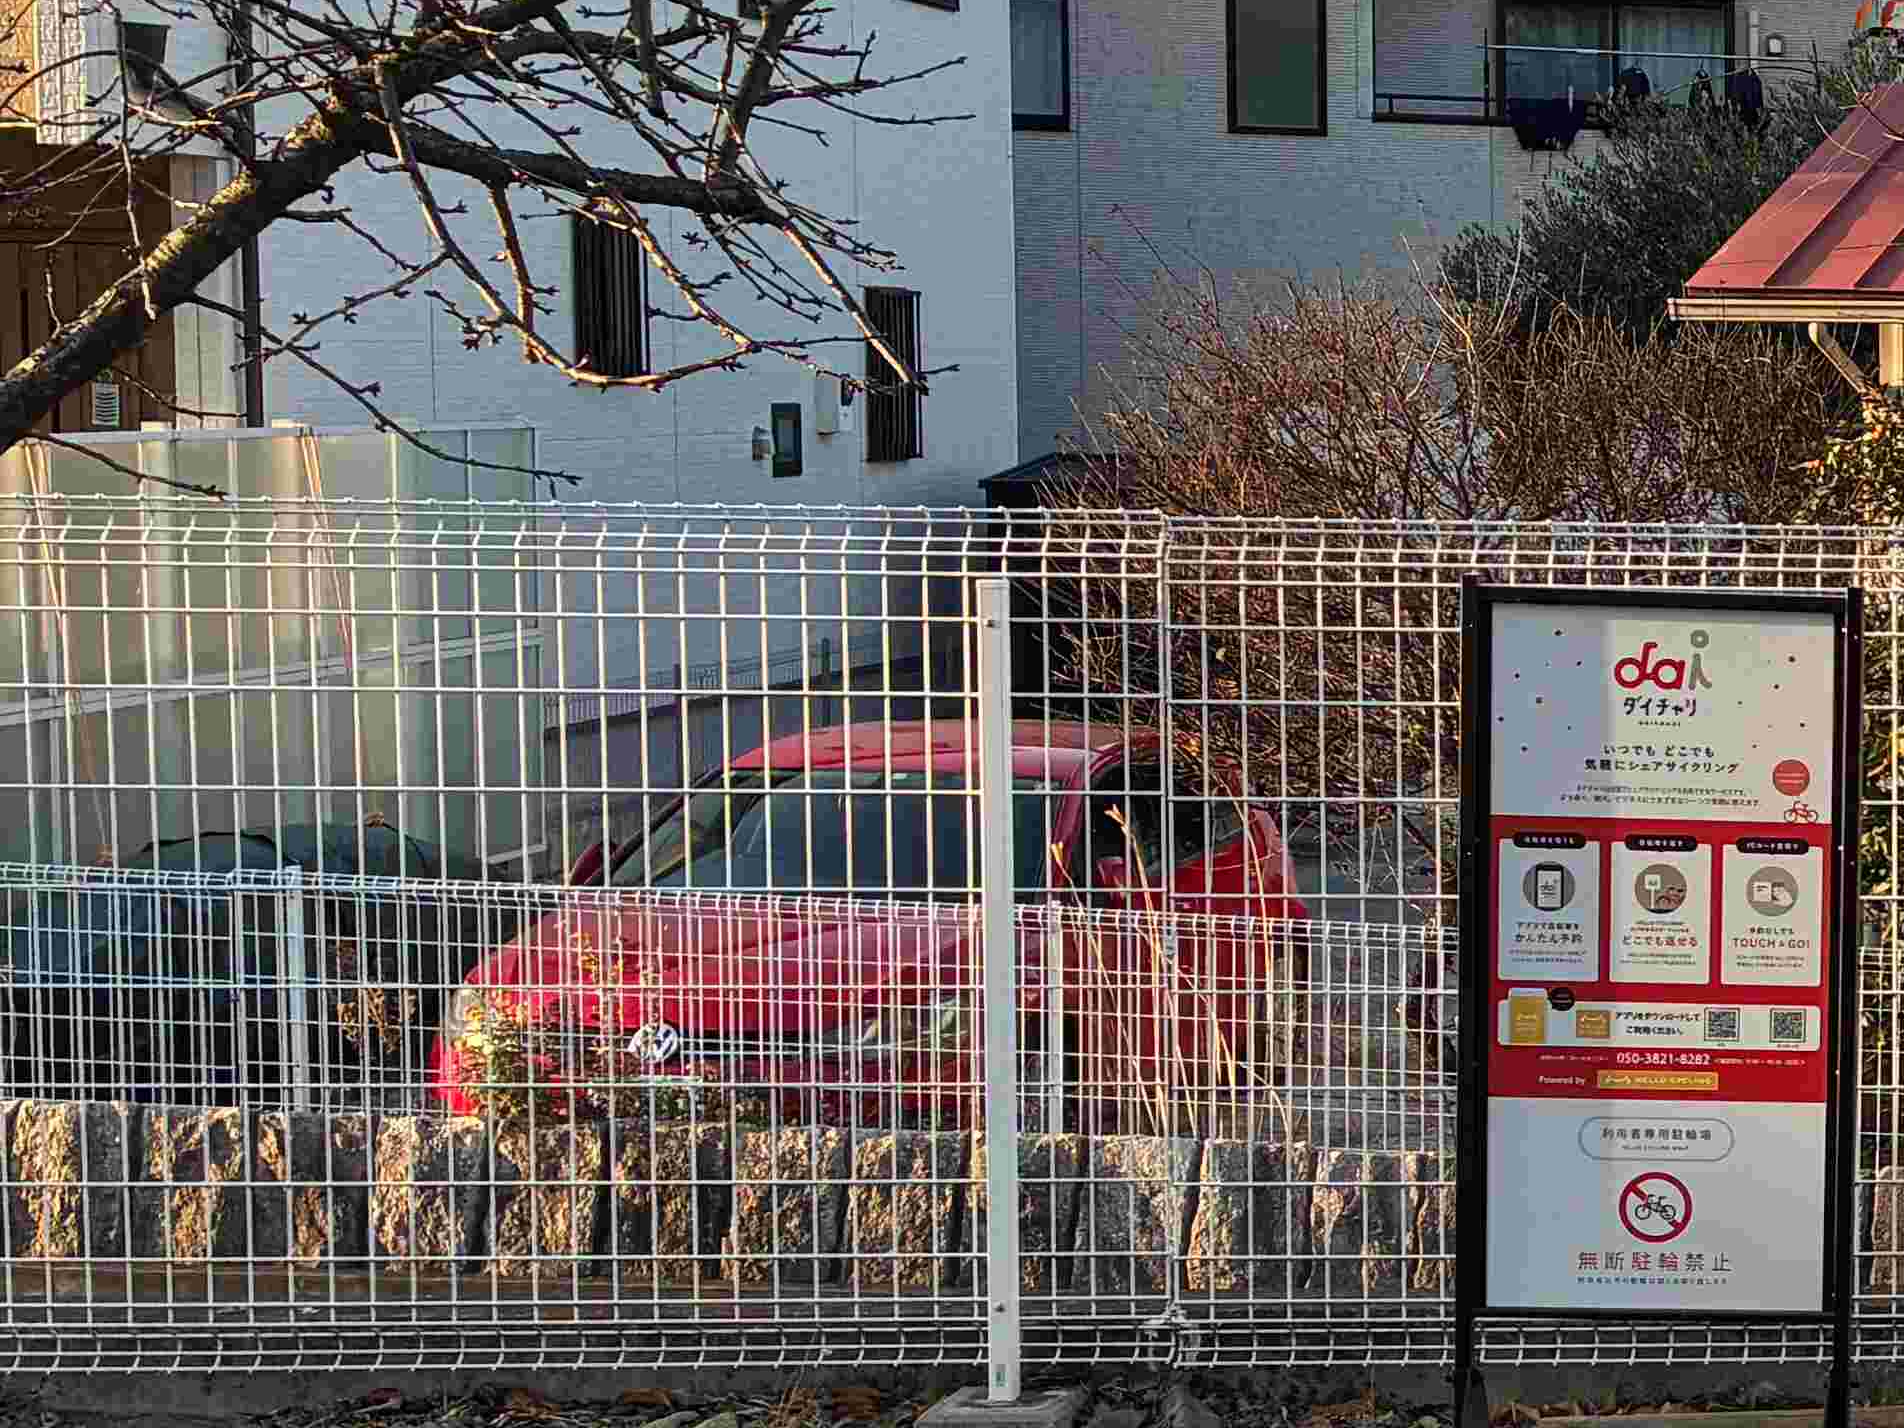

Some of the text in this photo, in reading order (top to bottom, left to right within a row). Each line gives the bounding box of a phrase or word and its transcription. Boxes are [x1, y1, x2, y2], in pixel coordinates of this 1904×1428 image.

[1623, 696, 1697, 717] ダイチャリ
[1602, 745, 1715, 758] いつでも どこでも
[1584, 758, 1738, 774] 気軽にシェアサイクリング
[1732, 937, 1775, 949] TOUCH
[1616, 1052, 1711, 1065] 050-3821-8282
[1577, 1251, 1733, 1272] 無断駐輪禁止
